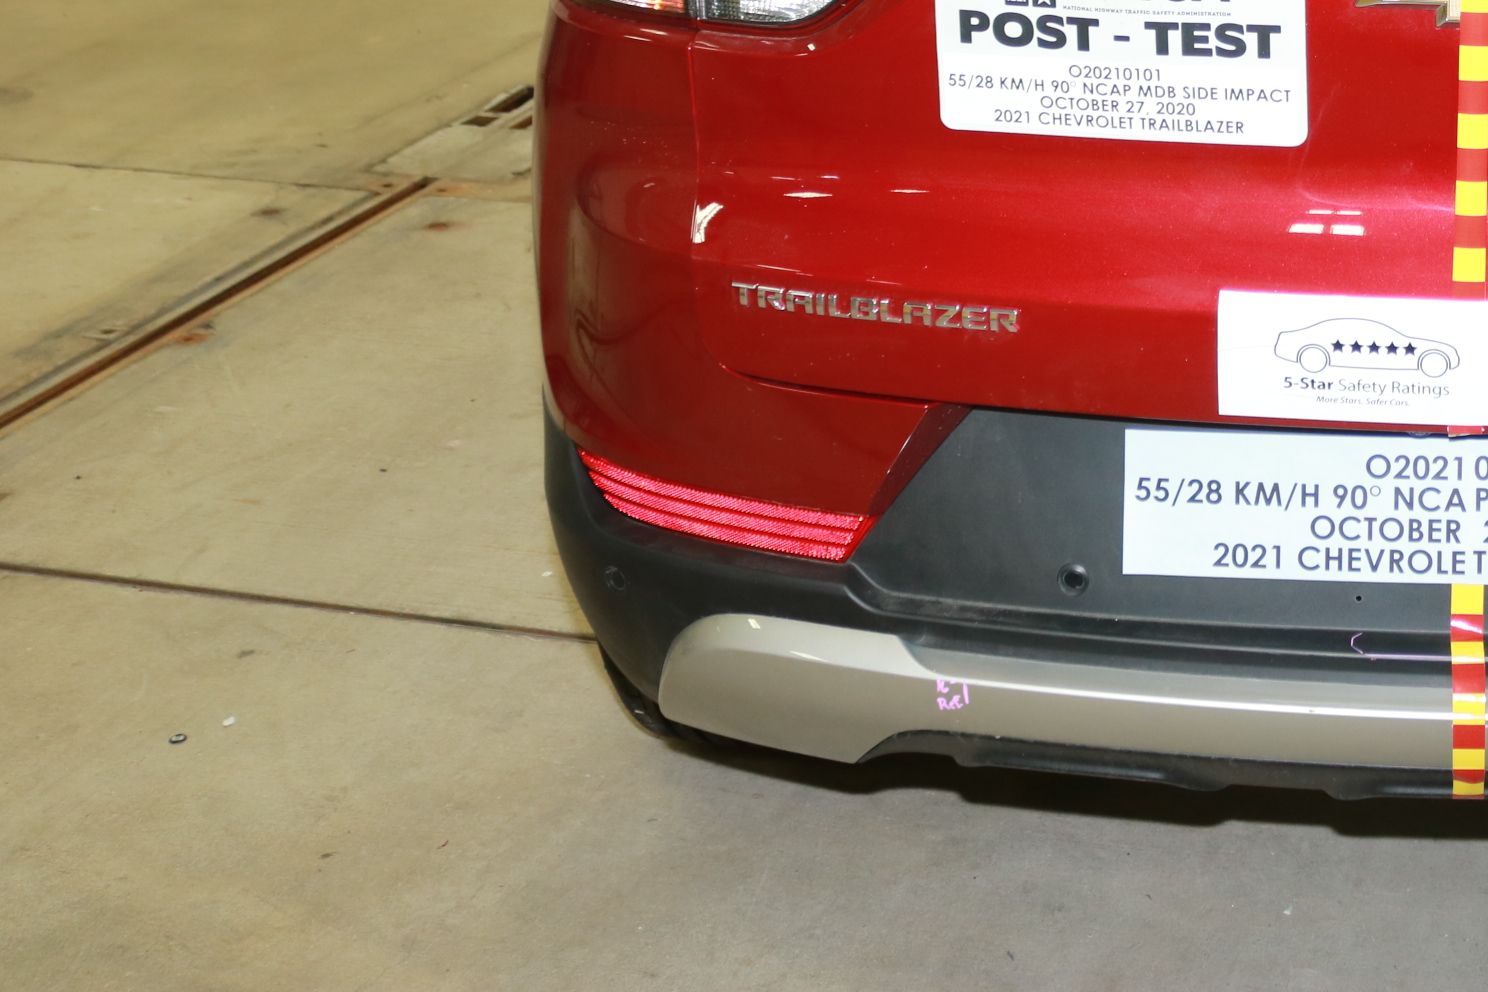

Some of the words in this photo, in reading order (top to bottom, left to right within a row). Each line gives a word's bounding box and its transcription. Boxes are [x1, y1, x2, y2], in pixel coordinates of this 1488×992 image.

[959, 9, 1099, 51] POST
[1144, 21, 1281, 59] TEST
[948, 73, 994, 89] 55/28
[999, 77, 1045, 93] KM/H
[1082, 82, 1131, 97] NCAP
[1137, 85, 1177, 99] MDB
[1182, 86, 1218, 100] SIDE
[1224, 88, 1291, 103] IMPACT
[1040, 95, 1120, 113] OCTOBER
[1125, 101, 1150, 116] 27,
[1156, 102, 1196, 116] 2020
[994, 109, 1031, 124] 2021
[1038, 111, 1134, 129] CHEVROLET
[1139, 117, 1245, 135] TRAILBLAZER
[731, 281, 1021, 333] TRAILBLAZER
[1283, 376, 1334, 391] 5-Star
[1338, 378, 1387, 396] Safety
[1391, 381, 1450, 399] Ratings
[1316, 395, 1339, 404] More
[1340, 396, 1363, 405] Stars.
[1366, 398, 1388, 407] Safer
[1390, 399, 1411, 407] Cars.
[1135, 477, 1223, 507] 55/28
[1234, 481, 1320, 511] KM/H
[1310, 515, 1462, 544] OCTOBER
[1212, 542, 1282, 569] 2021
[1297, 545, 1487, 576] CHEVROLET
